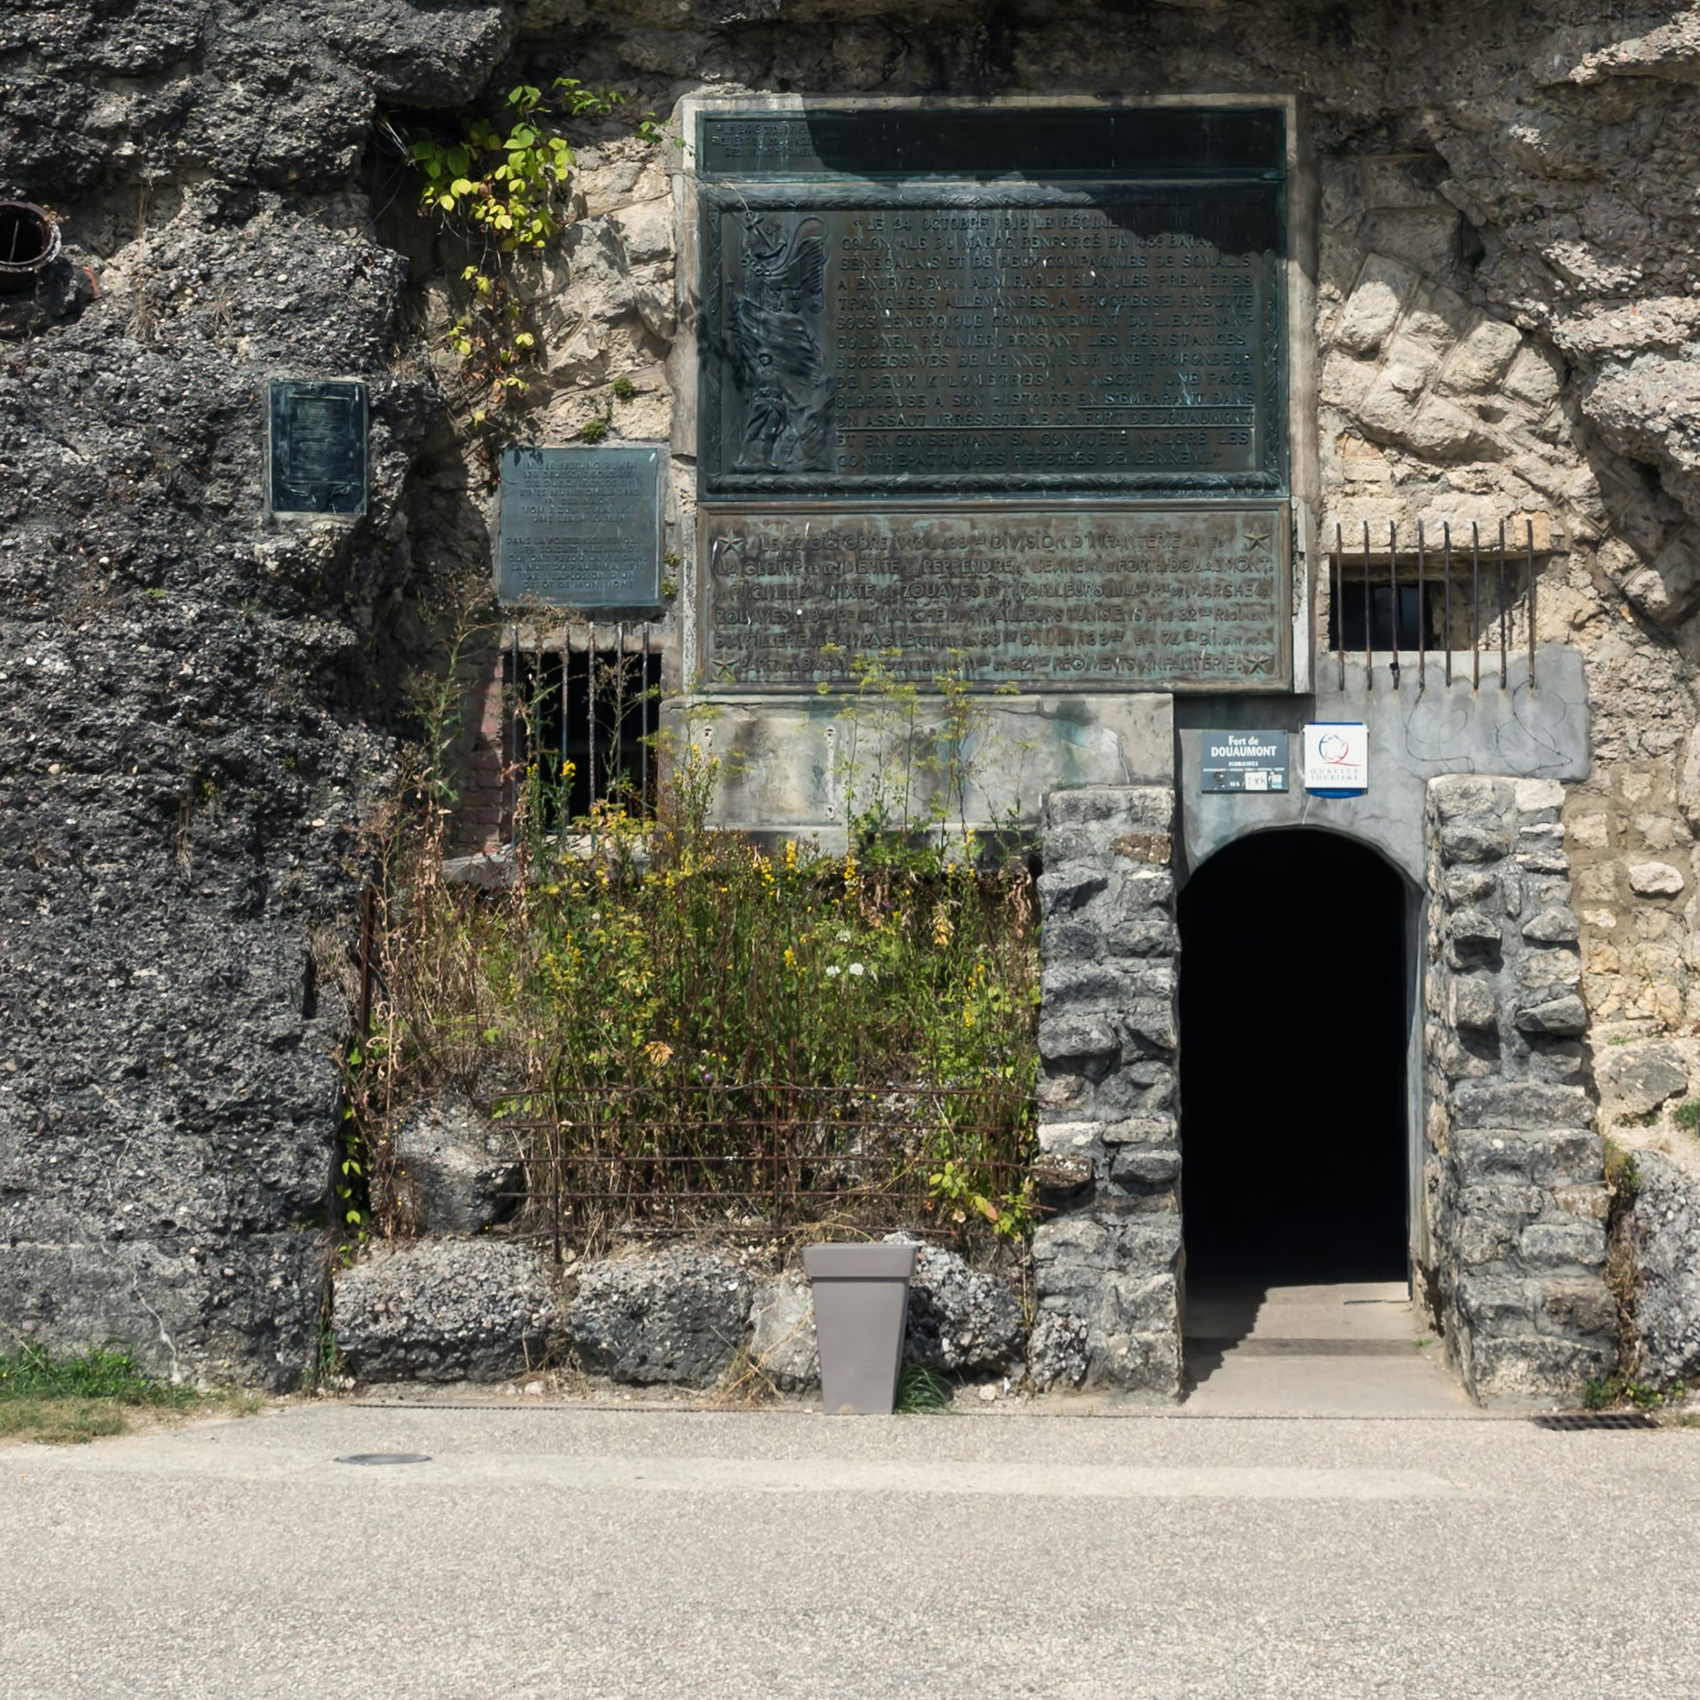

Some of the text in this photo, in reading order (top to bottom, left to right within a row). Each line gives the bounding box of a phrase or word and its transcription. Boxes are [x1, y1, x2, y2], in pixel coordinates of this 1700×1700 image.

[922, 216, 988, 230] OCTOBRE
[996, 216, 1028, 230] 1916
[1036, 216, 1053, 230] LE
[842, 236, 927, 250] COLONIALE
[937, 235, 954, 249] DU
[963, 235, 1014, 249] MAROC
[947, 255, 966, 269] ET
[972, 255, 992, 269] DE
[999, 255, 1040, 269] DEUX
[1046, 255, 1148, 268] COMPAGNIES
[1155, 254, 1175, 268] DE
[1182, 254, 1252, 268] SOMALIS
[972, 276, 1066, 289] ADMIRABLE
[1123, 275, 1150, 288] LES
[1179, 294, 1254, 308] ENSUITE
[835, 316, 877, 330] SOUS
[993, 315, 1121, 329] COMMANDEMENT
[1127, 315, 1148, 328] DU
[836, 336, 916, 349] COLONEL
[1006, 335, 1080, 348] BRISANT
[1088, 334, 1118, 348] LES
[835, 355, 950, 368] SUCCESSIVES
[957, 354, 979, 368] DE
[1069, 353, 1100, 367] SUR
[1109, 353, 1142, 367] UNE
[1149, 352, 1254, 366] PROFONDEUR
[836, 375, 858, 388] DE
[869, 375, 916, 388] DEUX
[1084, 373, 1154, 386] INSCRIT
[1164, 373, 1199, 386] UNE
[1208, 372, 1253, 386] PAGE
[836, 394, 927, 409] GLORIEUSE
[952, 394, 982, 408] SON
[993, 393, 1070, 407] HISTOIRE
[1077, 393, 1098, 407] EN
[1213, 392, 1256, 405] DANS
[836, 414, 857, 427] UN
[865, 414, 926, 427] ASSAUT
[1056, 413, 1077, 426] DU
[1084, 413, 1123, 426] FORT
[1131, 413, 1149, 426] DE
[1157, 412, 1254, 425] DOUAUMONT
[836, 434, 855, 447] ET
[865, 434, 888, 447] EN
[895, 433, 1002, 447] CONSERVANT
[1010, 433, 1030, 446] SA
[1217, 432, 1249, 445] LES
[1105, 453, 1127, 466] DE
[810, 536, 890, 550] OCTOBRE
[990, 535, 1067, 549] DIVISION
[743, 560, 802, 575] GLOIRE
[922, 559, 1013, 574] REPRENDRE
[903, 584, 980, 598] ZOUAVES
[1228, 735, 1259, 746] Fort de
[1211, 746, 1277, 757] DOUAUMONT
